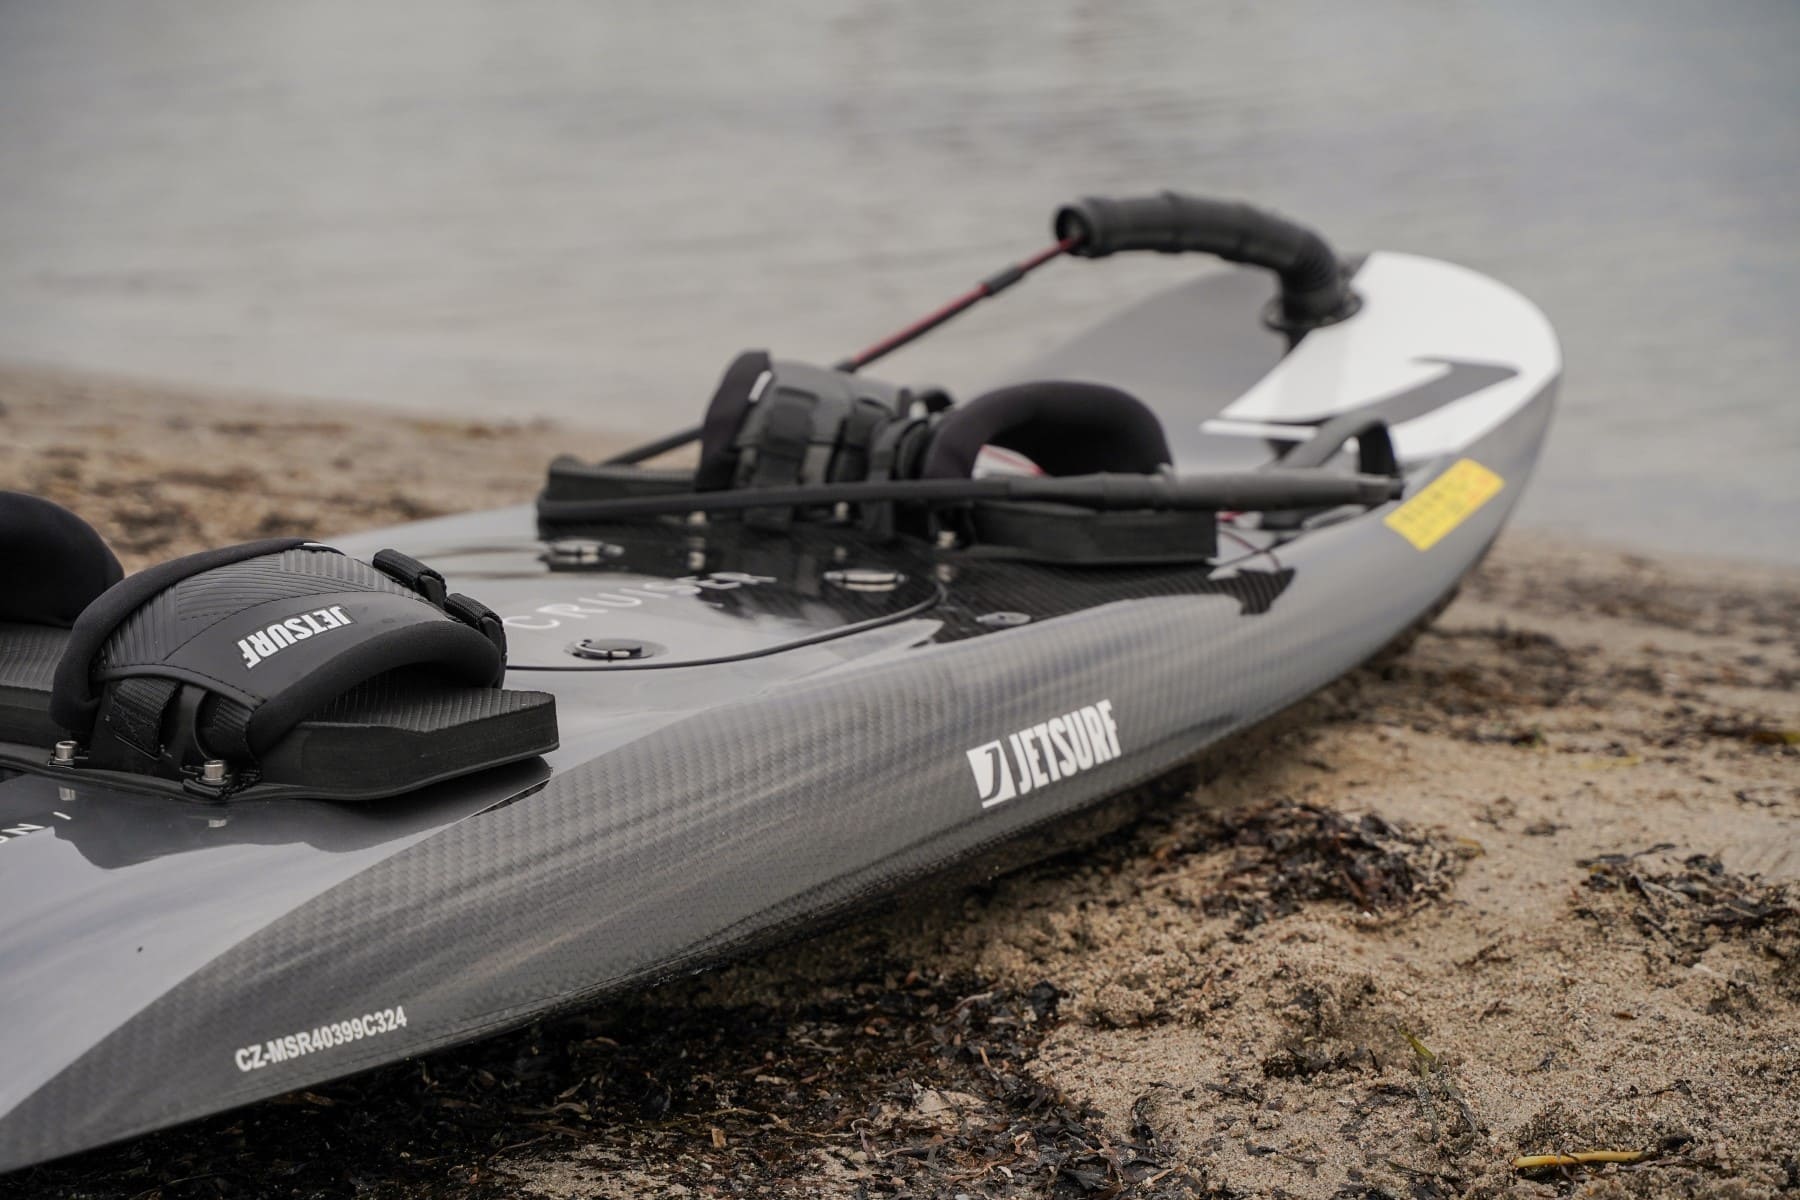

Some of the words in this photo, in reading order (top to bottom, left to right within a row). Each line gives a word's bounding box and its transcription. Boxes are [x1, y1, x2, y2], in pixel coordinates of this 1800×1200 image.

[502, 572, 777, 630] CRUISER
[237, 605, 352, 669] JETSURF
[1008, 699, 1122, 796] JETSURF
[234, 1005, 408, 1073] CZ-MSR40399C324
